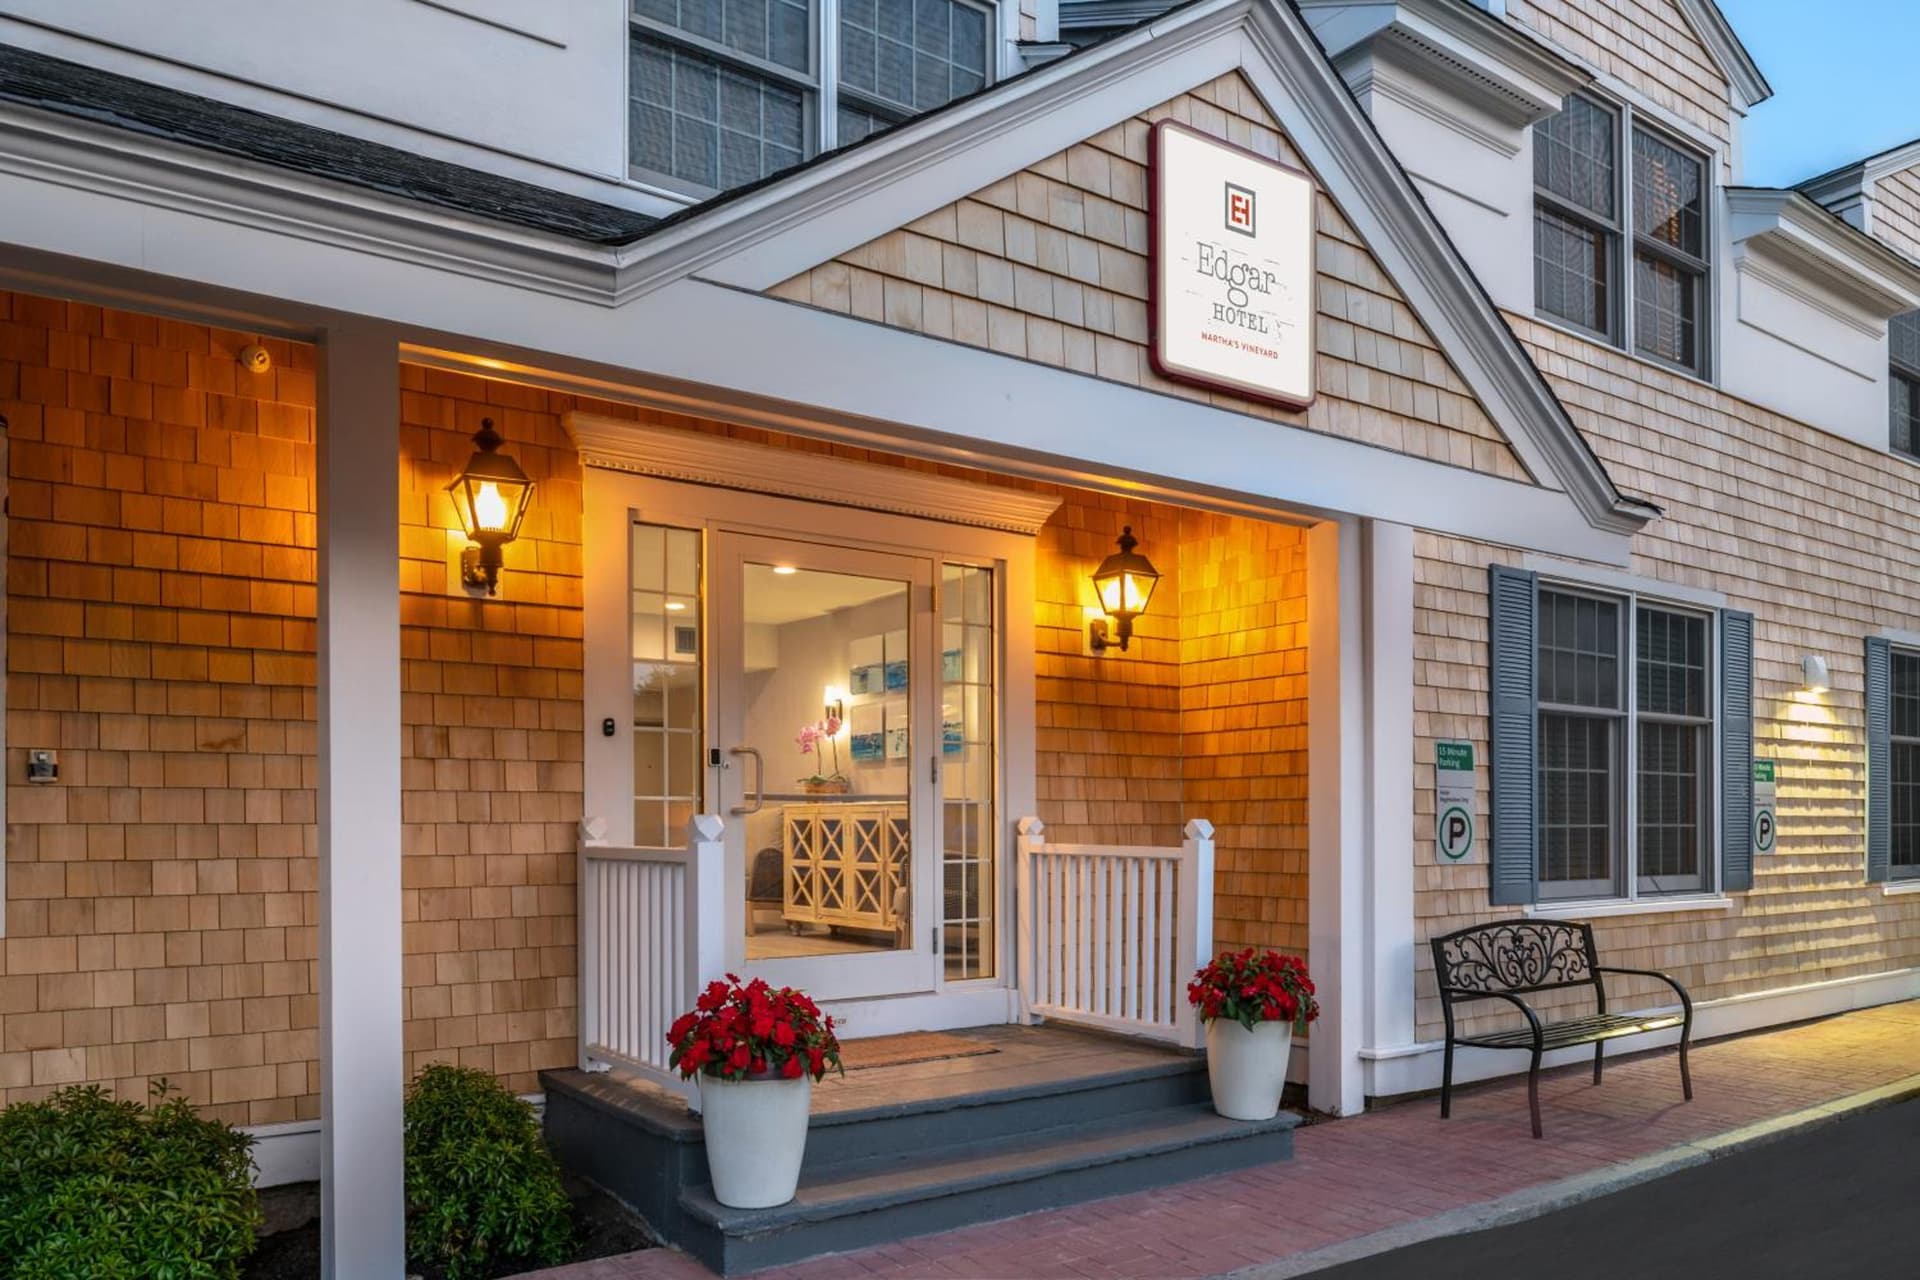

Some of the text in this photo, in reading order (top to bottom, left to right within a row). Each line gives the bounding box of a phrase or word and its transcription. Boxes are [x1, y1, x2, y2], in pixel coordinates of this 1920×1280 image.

[1196, 241, 1275, 308] Edgar
[1212, 302, 1268, 334] HOTEL
[1201, 331, 1278, 359] MARTHA'S VINEYARD
[1449, 817, 1466, 849] P
[1760, 818, 1770, 844] P
